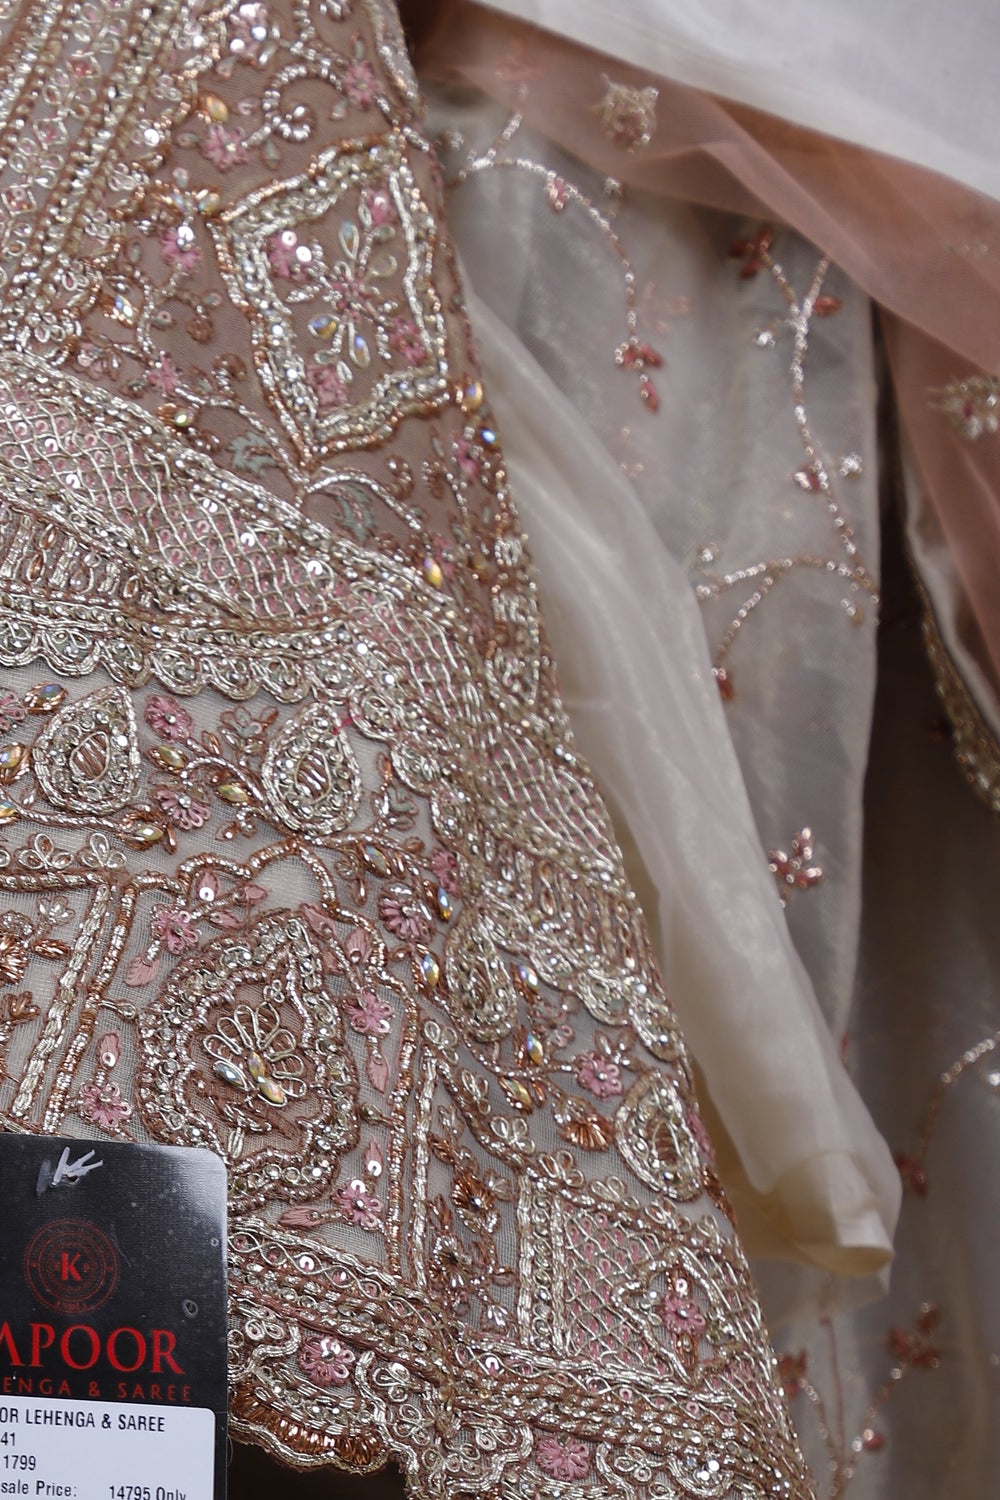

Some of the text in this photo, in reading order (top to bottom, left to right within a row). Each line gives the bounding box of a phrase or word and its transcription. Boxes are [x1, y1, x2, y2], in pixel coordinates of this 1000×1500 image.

[88, 1380, 101, 1395] &
[118, 1382, 192, 1402] SAREE
[26, 1408, 96, 1428] LEHENGA
[101, 1413, 112, 1429] &
[117, 1414, 166, 1432] SAREE
[35, 1480, 78, 1498] Price:
